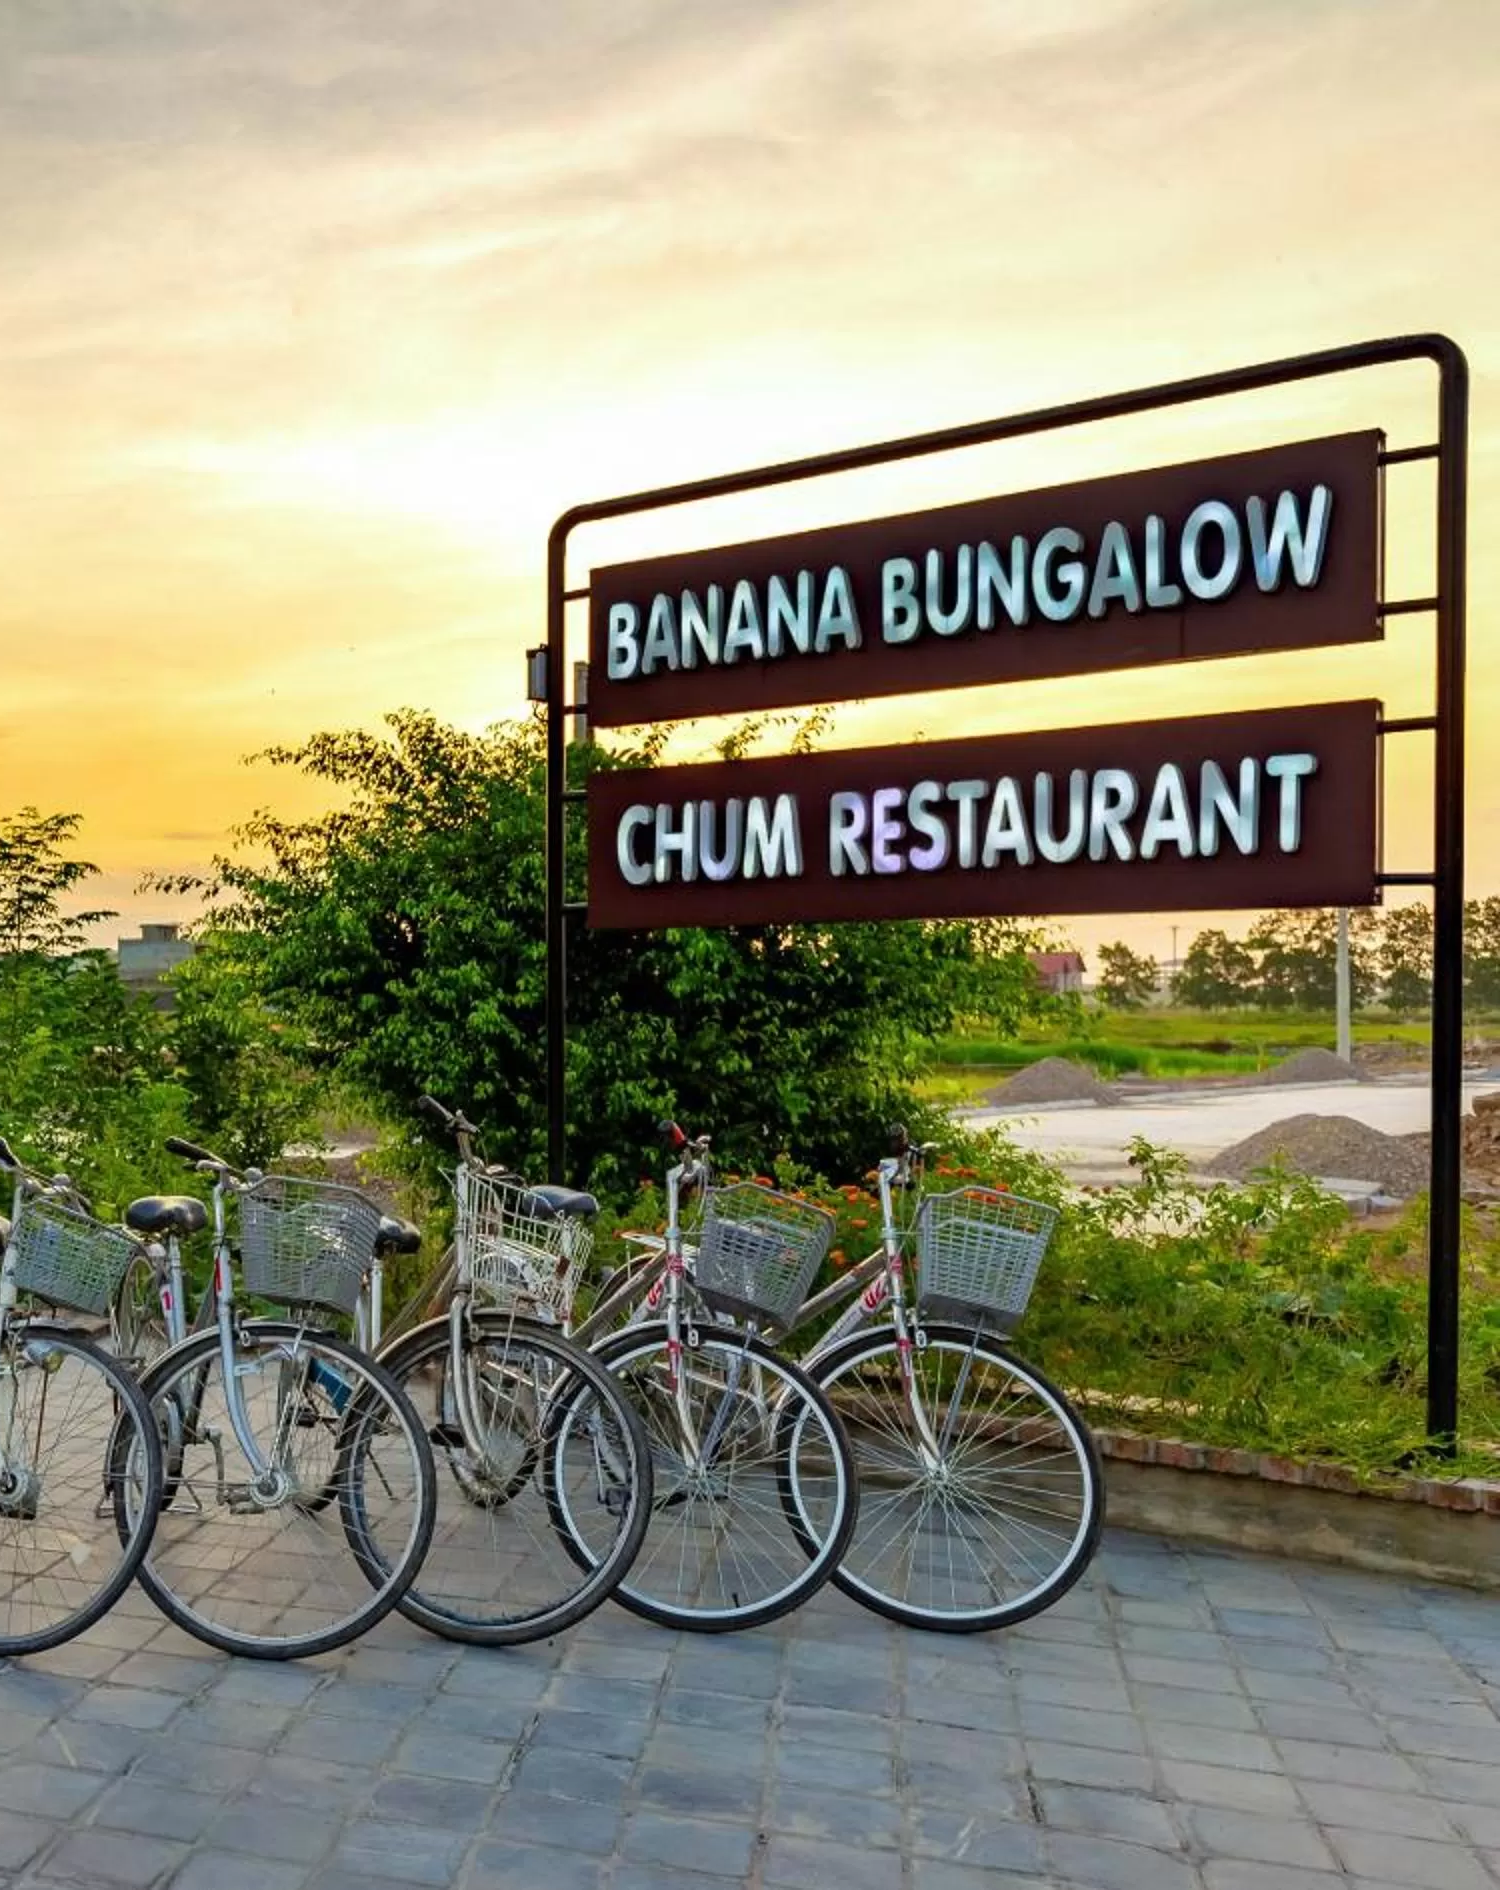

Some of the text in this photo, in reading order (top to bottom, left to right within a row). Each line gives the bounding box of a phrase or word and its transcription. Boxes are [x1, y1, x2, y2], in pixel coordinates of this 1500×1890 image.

[606, 483, 1333, 681] BANANA BUNGALOW
[616, 752, 1319, 886] CHUM RESTAURANT
